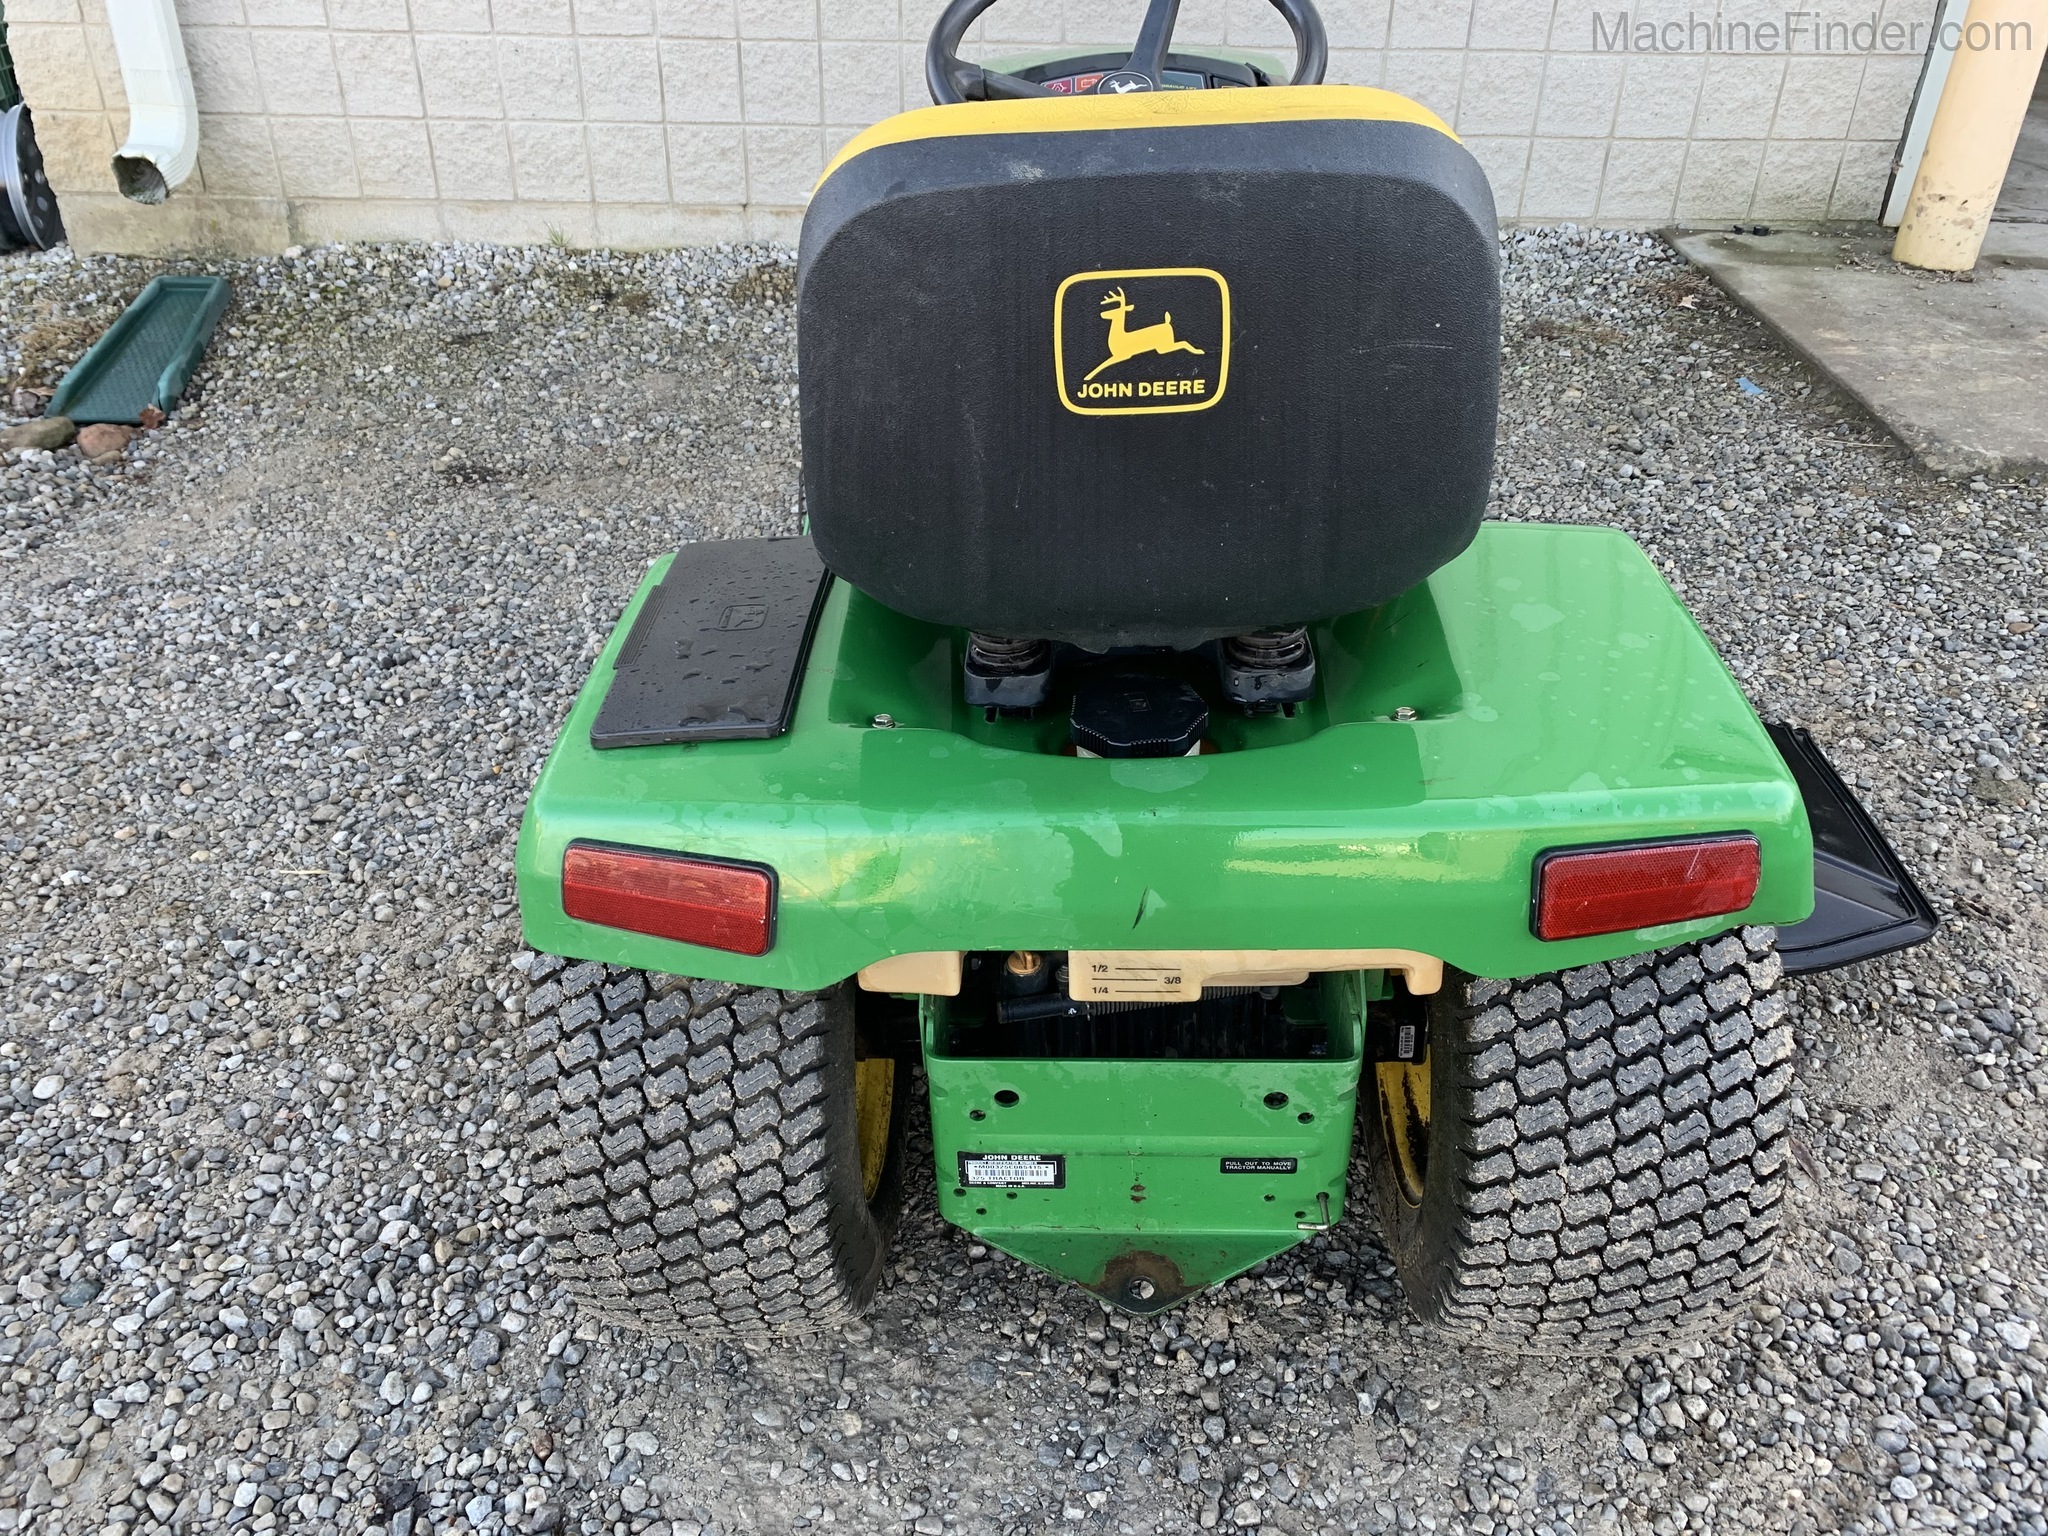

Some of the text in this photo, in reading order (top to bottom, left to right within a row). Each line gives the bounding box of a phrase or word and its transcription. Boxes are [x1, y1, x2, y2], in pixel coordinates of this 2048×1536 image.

[1077, 379, 1206, 398] JOHN DEERE
[1091, 965, 1109, 973] 1/2
[1164, 976, 1182, 985] 3/8
[1091, 986, 1109, 994] 1/4
